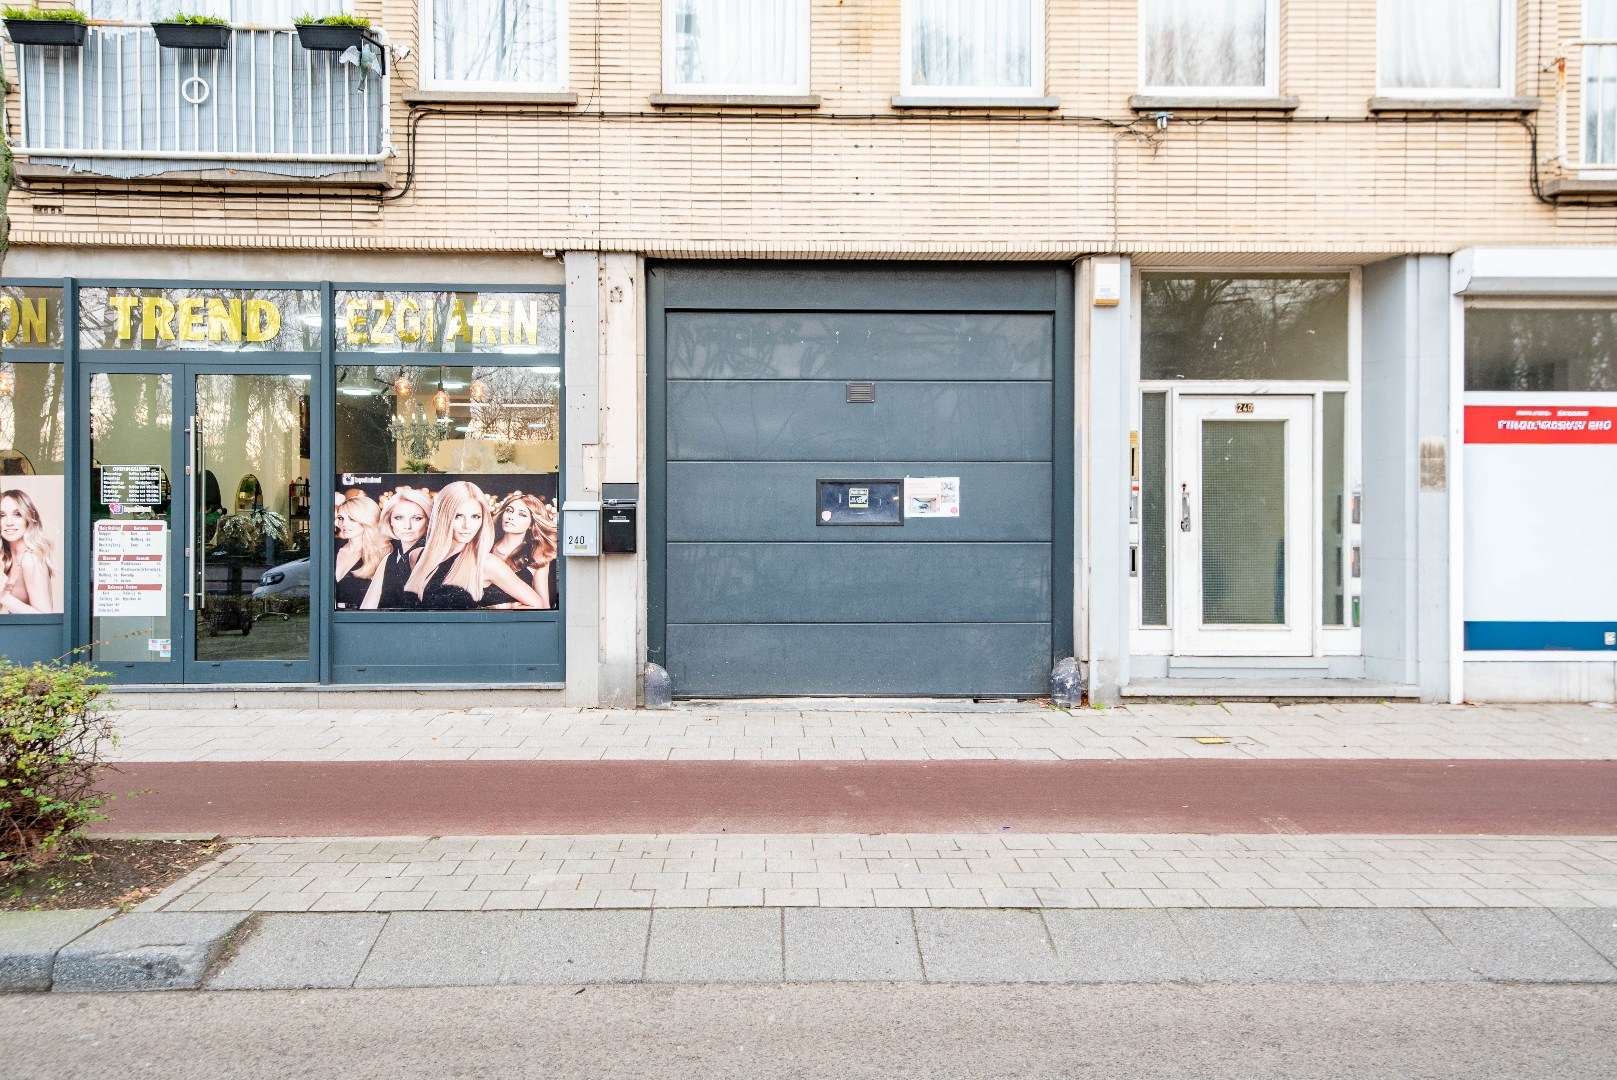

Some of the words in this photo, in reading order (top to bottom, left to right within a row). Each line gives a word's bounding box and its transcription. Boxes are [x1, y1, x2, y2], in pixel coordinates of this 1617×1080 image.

[110, 296, 281, 342] TREND
[346, 299, 434, 344] EZGI
[446, 298, 538, 345] AKIN
[1237, 403, 1253, 412] 240
[568, 535, 585, 545] 240
